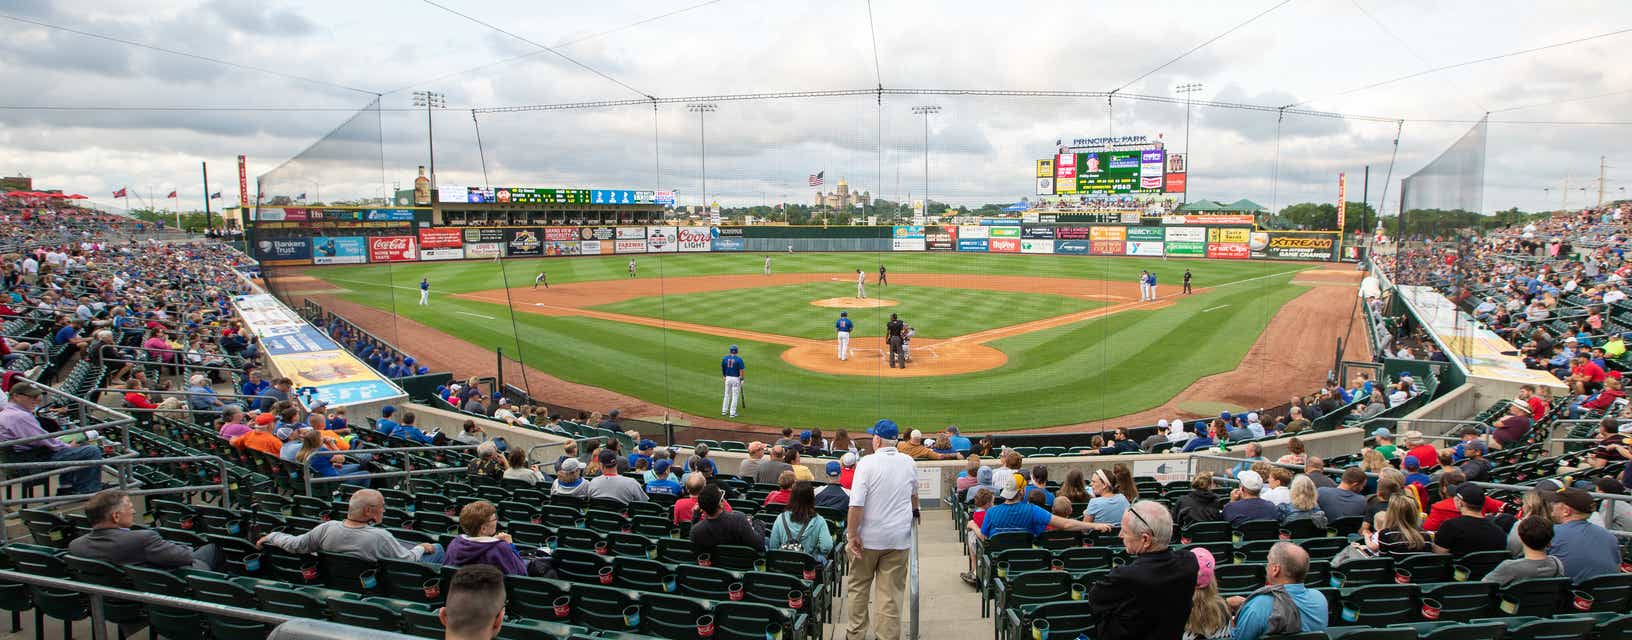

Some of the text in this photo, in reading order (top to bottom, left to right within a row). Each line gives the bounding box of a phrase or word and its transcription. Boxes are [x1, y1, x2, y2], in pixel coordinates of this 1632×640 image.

[1073, 135, 1147, 145] PRINCIPAL PARK
[678, 229, 711, 243] Coors
[274, 240, 306, 248] Bankers
[373, 238, 407, 250] Coca-Cola
[1271, 238, 1332, 247] XTREAM
[1230, 245, 1248, 253] Clips
